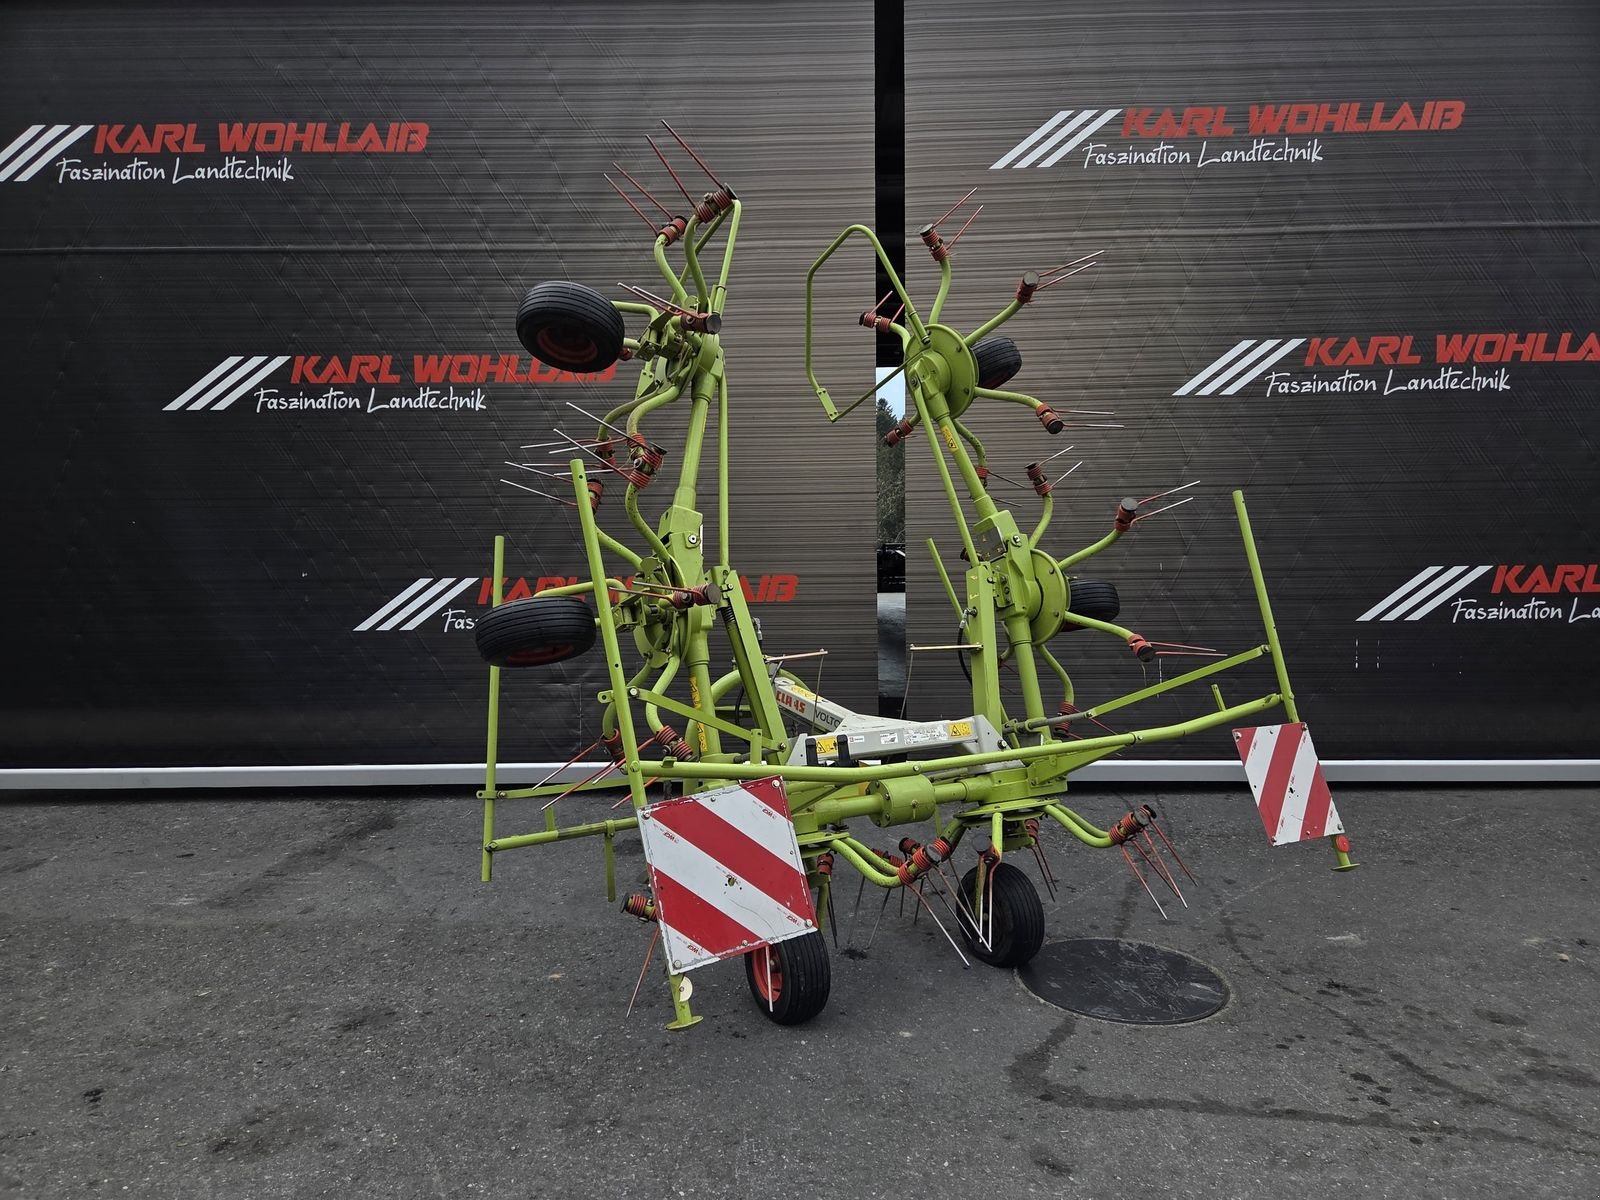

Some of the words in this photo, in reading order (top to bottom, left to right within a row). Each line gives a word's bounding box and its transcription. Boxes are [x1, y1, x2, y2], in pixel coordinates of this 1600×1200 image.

[1121, 107, 1234, 138] KARL
[94, 123, 206, 153] KARL
[1083, 142, 1191, 168] Faszination
[1197, 138, 1323, 168] Landtechnik
[56, 158, 166, 183] Faszination
[172, 156, 294, 184] Landtechnik
[1305, 336, 1422, 366] KARL
[291, 355, 401, 384] KARL
[1265, 371, 1377, 397] Faszination
[1384, 367, 1511, 395] Landtechnik
[255, 388, 361, 413] Faszination
[367, 387, 487, 413] Landtechnik
[1491, 564, 1600, 593] KARL
[1450, 597, 1562, 623] Faszination
[776, 691, 806, 714] CLAAS
